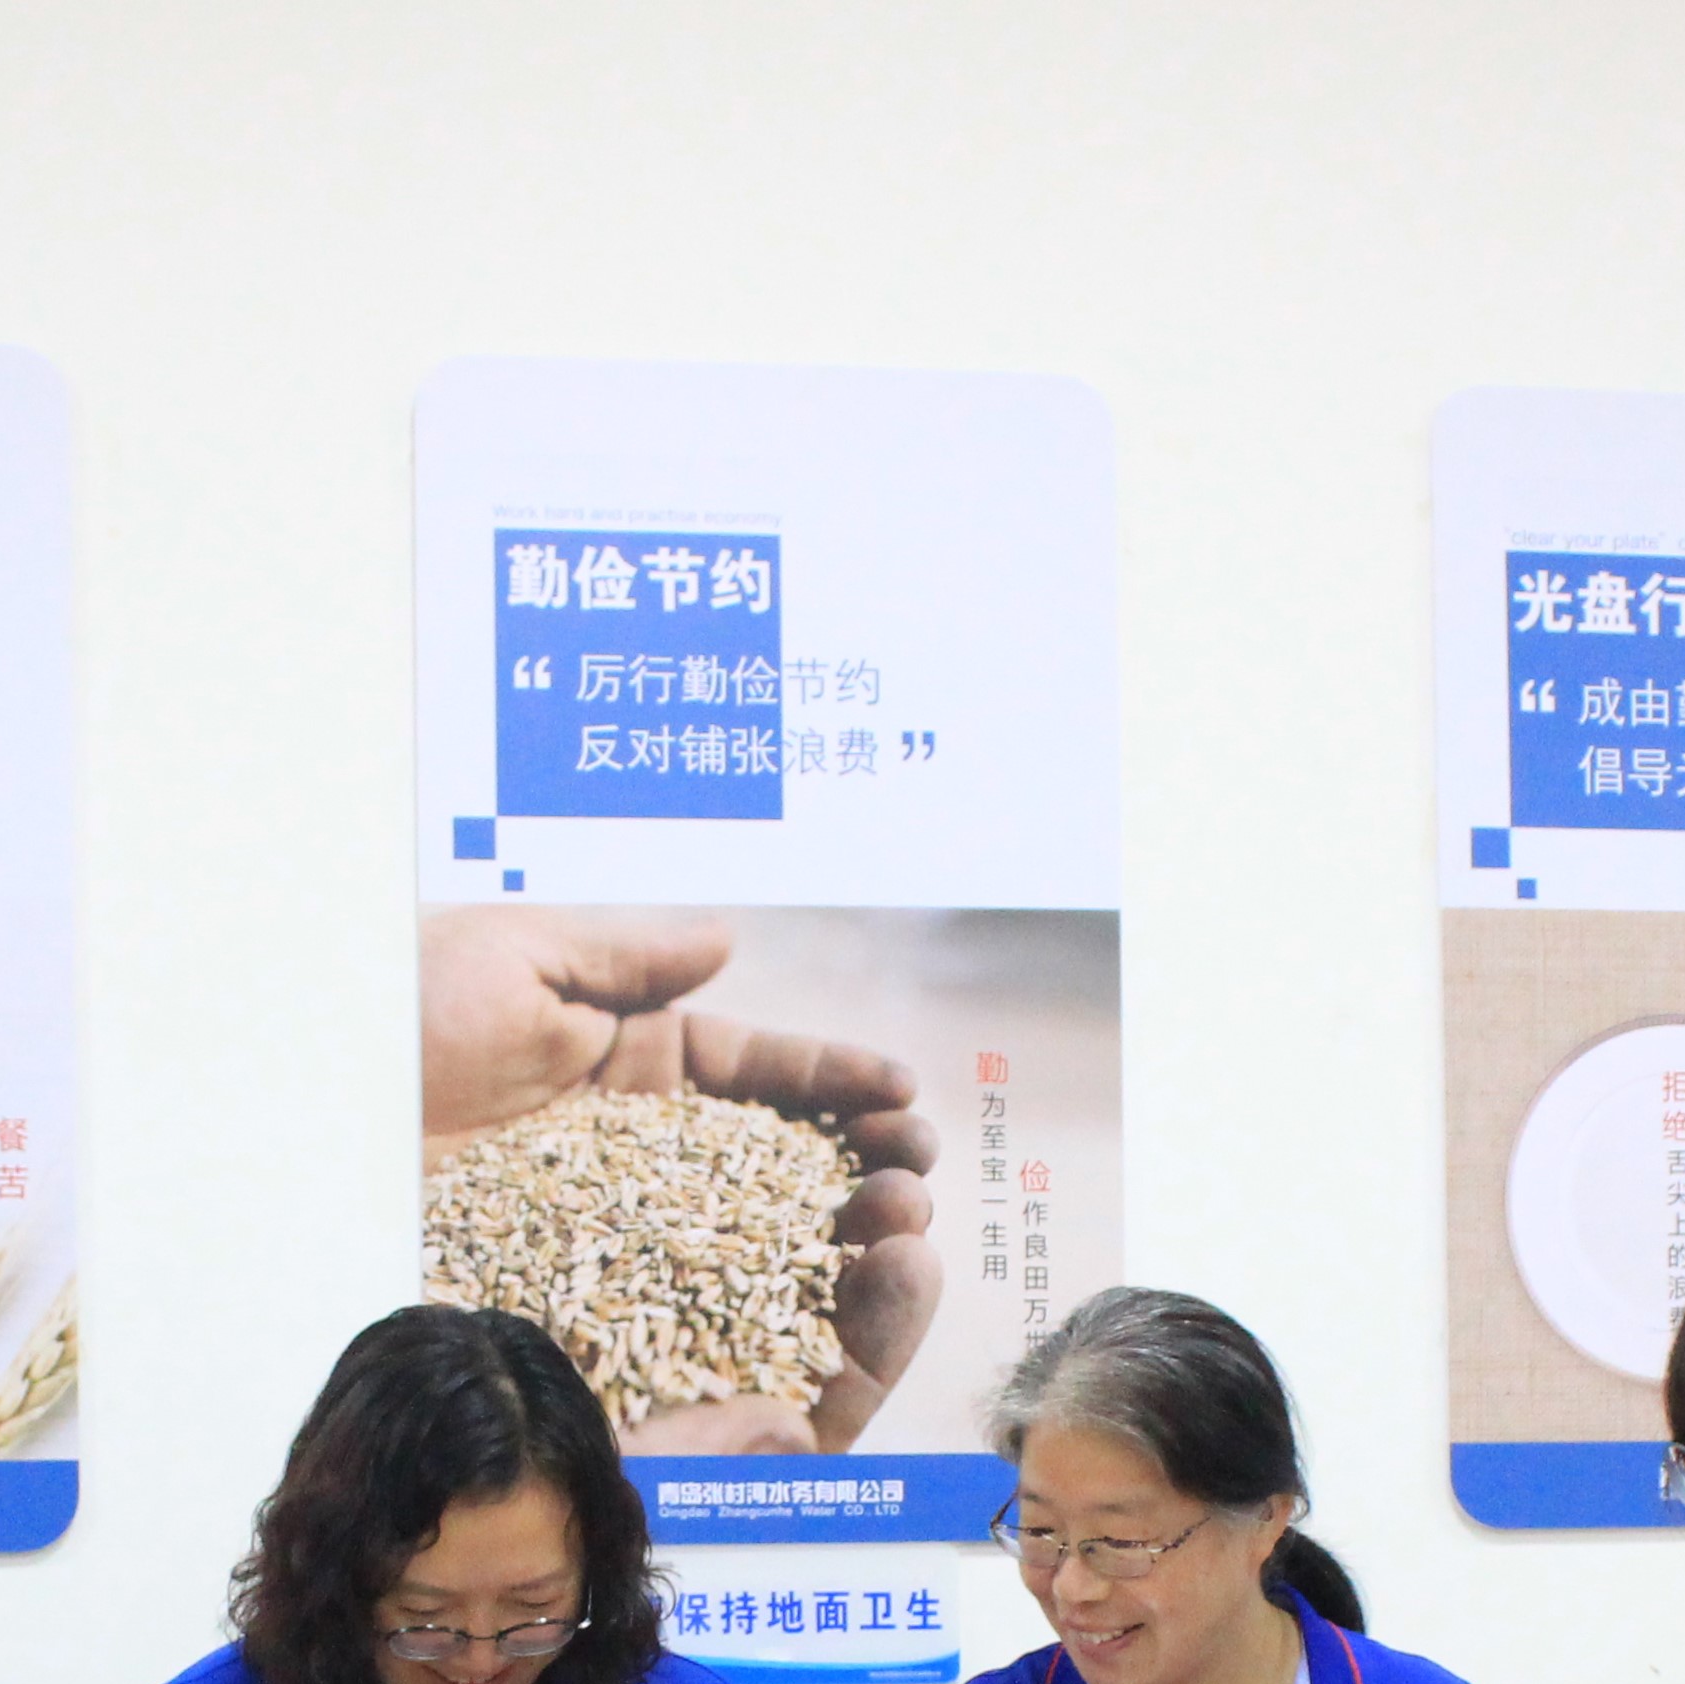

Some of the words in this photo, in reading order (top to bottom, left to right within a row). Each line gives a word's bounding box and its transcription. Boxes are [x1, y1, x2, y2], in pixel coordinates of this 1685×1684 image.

[492, 504, 537, 521] Work
[544, 505, 585, 521] hard
[590, 506, 622, 522] and
[704, 510, 782, 528] economy
[1564, 532, 1606, 551] your
[506, 543, 773, 614] 勤俭节约
[658, 1506, 712, 1520] Qingdao
[718, 1505, 793, 1520] Zhangcunhe
[800, 1504, 836, 1517] Water
[652, 1588, 944, 1636] 保持地面卫生
